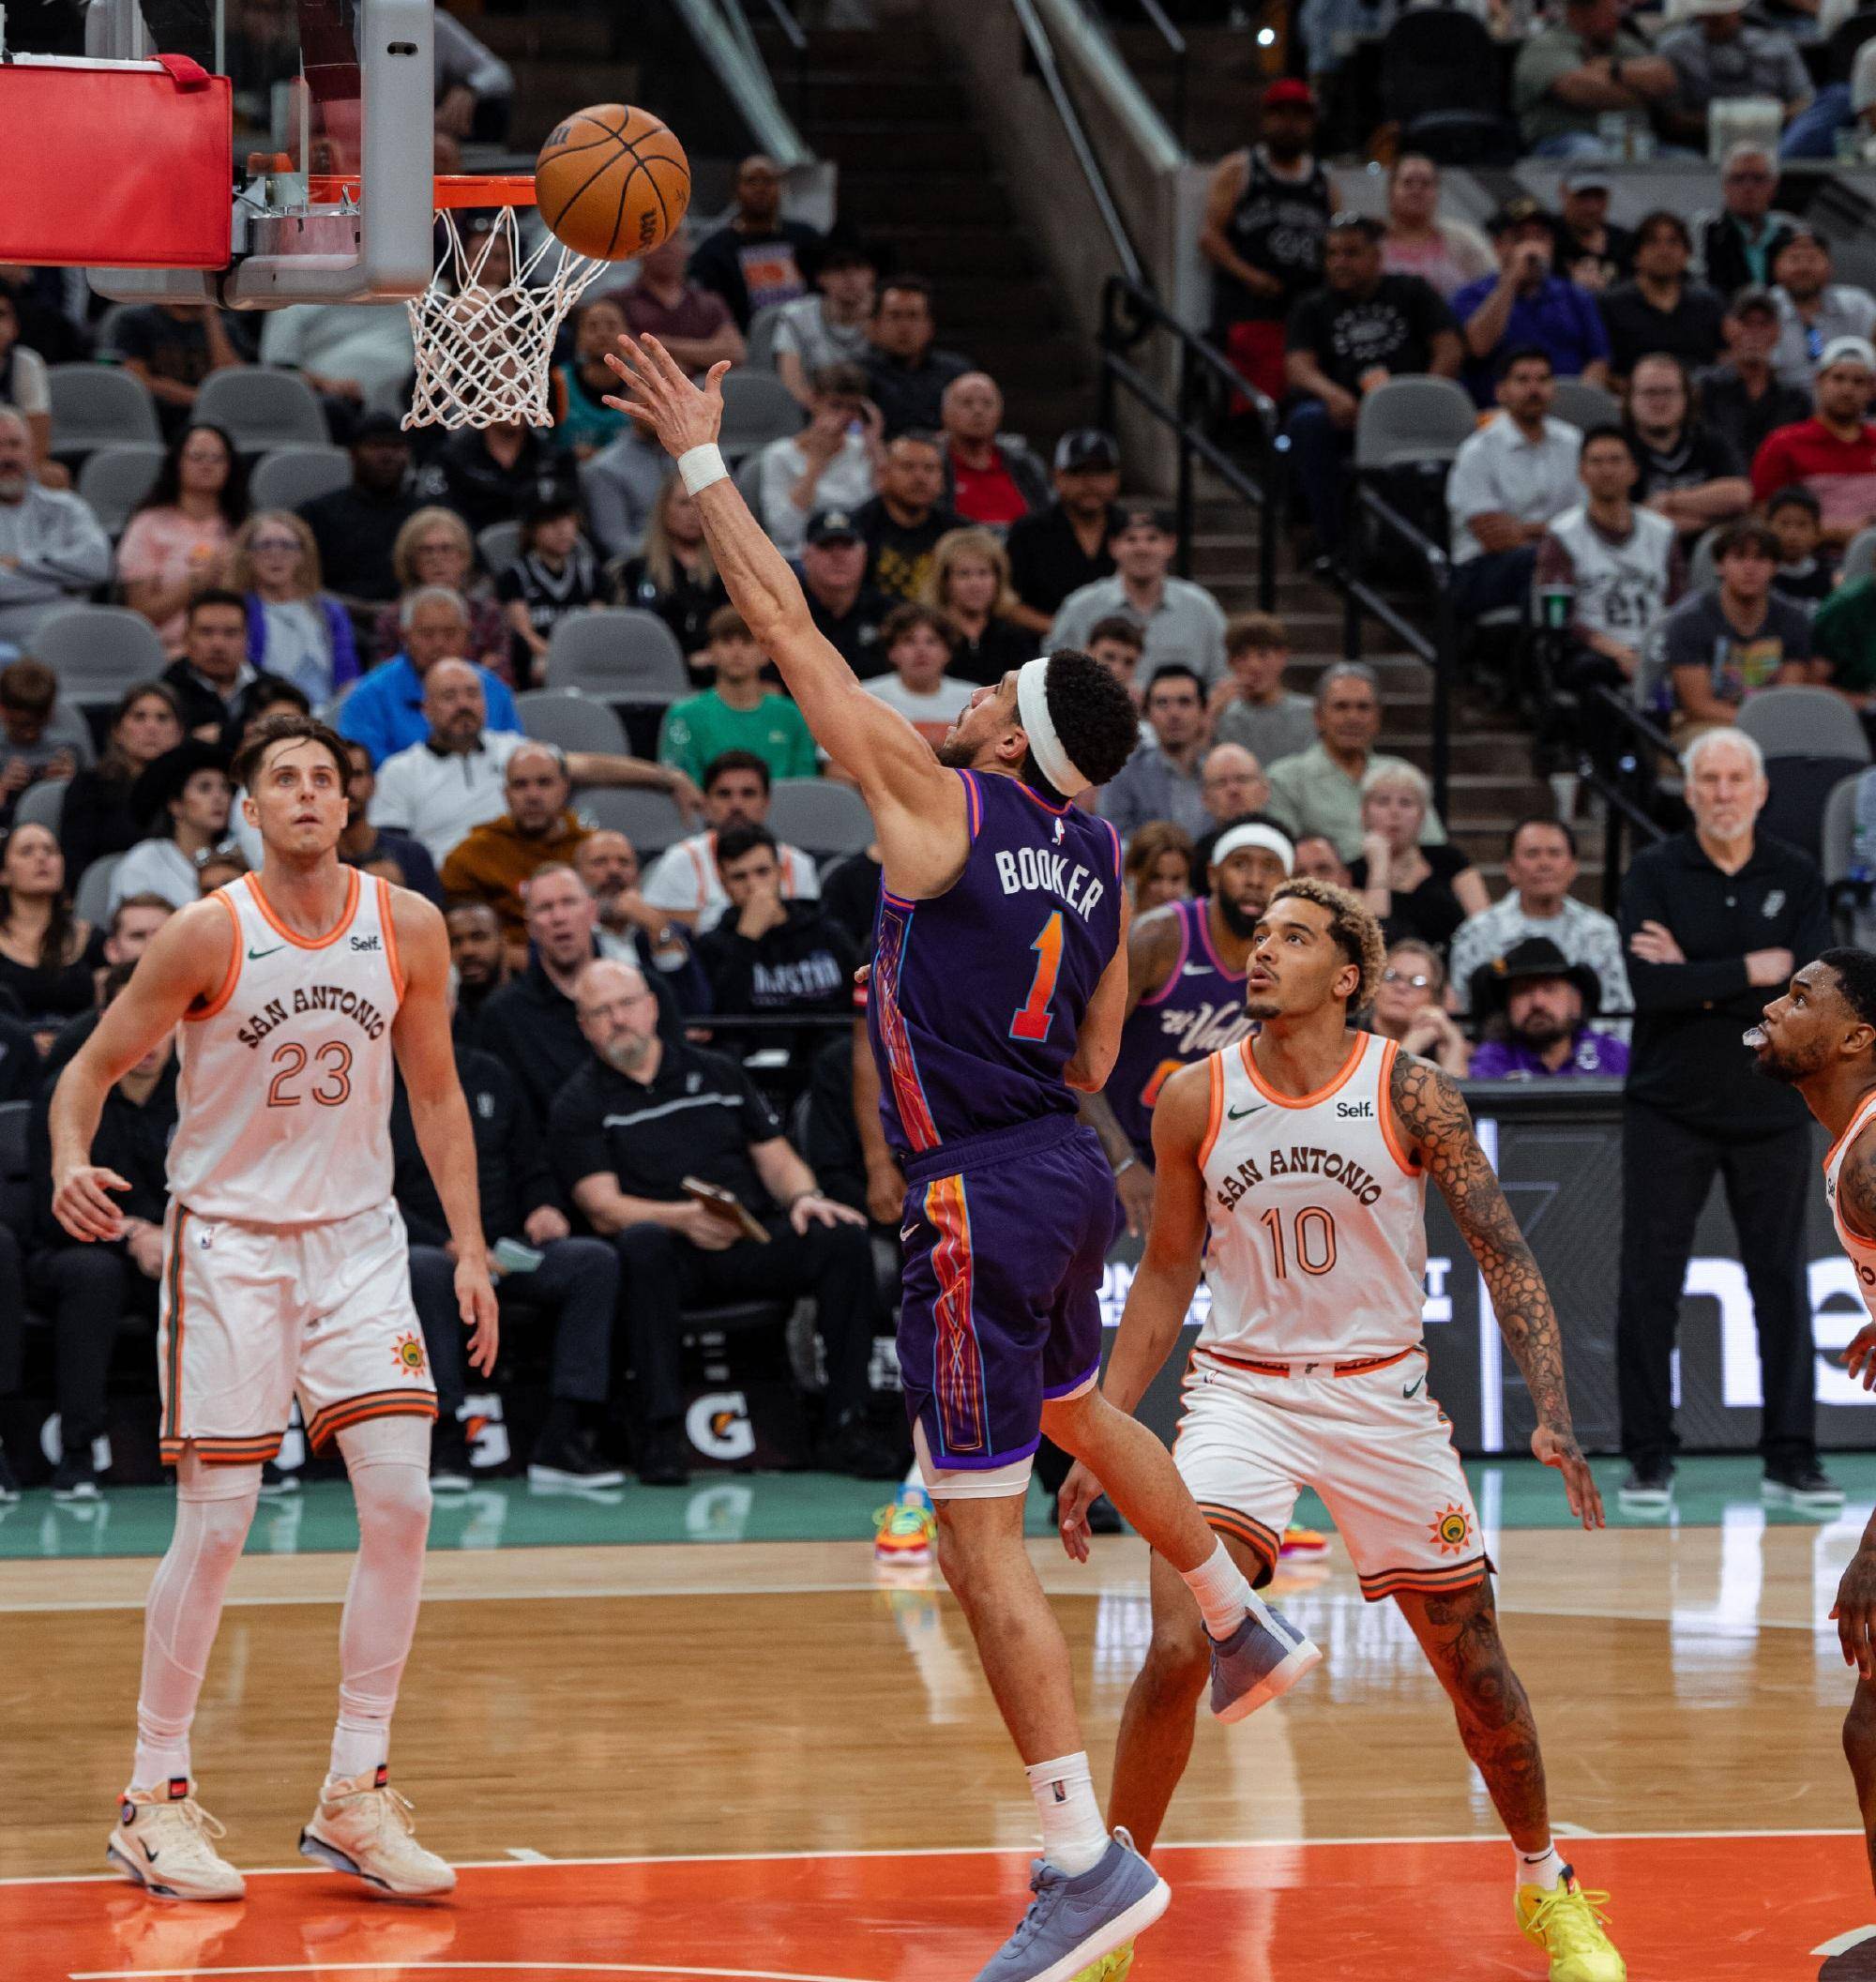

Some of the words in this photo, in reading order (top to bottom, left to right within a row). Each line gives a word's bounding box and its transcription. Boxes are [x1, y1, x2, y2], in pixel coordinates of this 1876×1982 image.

[994, 847, 1104, 923] BOOKER
[351, 935, 383, 952] Self.
[1008, 910, 1066, 1043] 1
[236, 998, 289, 1050] SAN
[293, 985, 386, 1041] ANTONIO
[266, 1040, 354, 1108] 23
[1337, 1101, 1374, 1118] Self.
[1217, 1158, 1264, 1213] SAN
[1269, 1146, 1383, 1207] ANTONIO
[1260, 1205, 1338, 1279] 10
[685, 1390, 757, 1460] G
